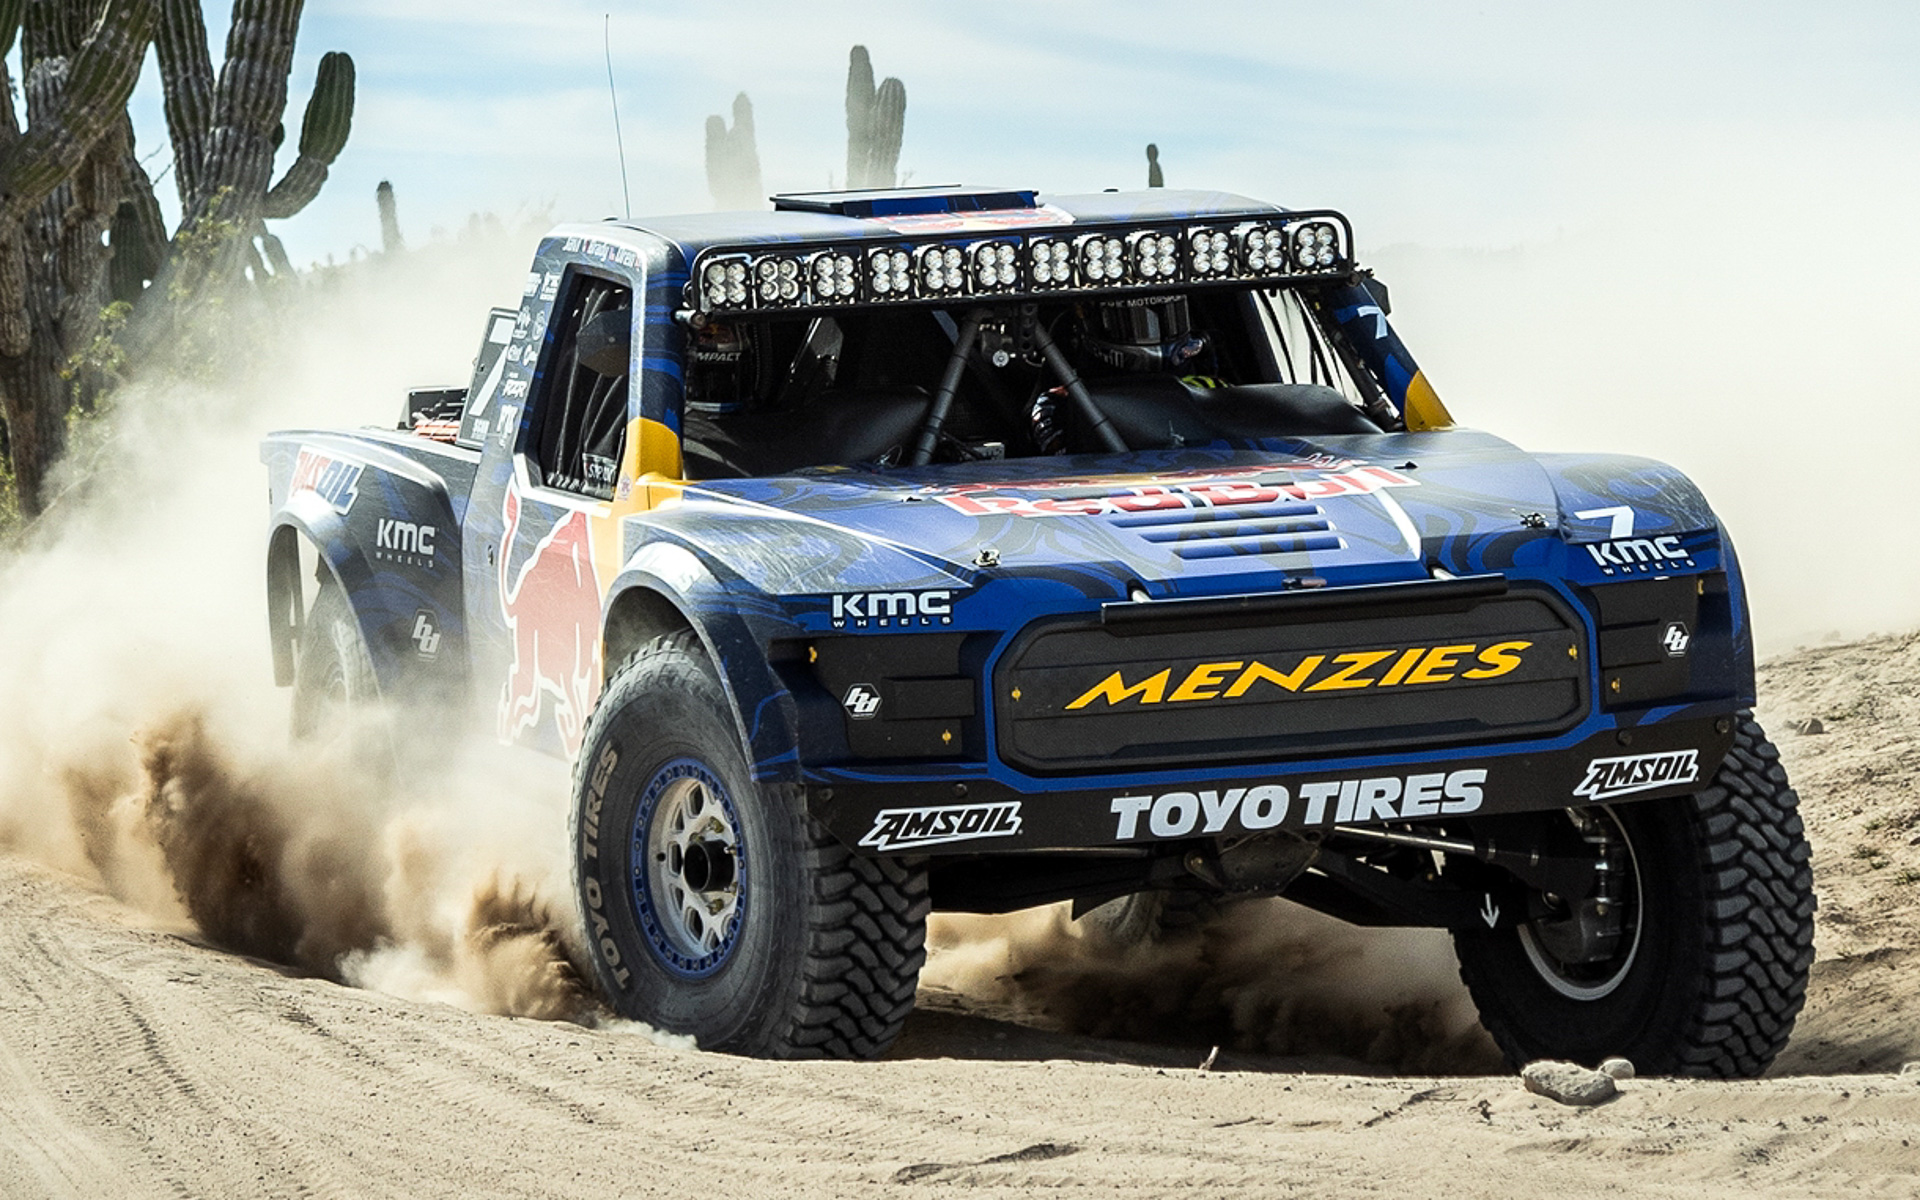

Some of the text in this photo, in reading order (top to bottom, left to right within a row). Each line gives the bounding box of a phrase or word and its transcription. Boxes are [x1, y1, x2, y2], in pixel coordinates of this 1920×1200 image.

[1357, 305, 1388, 339] 7
[377, 518, 435, 555] KMC
[1574, 506, 1634, 538] 7
[376, 552, 433, 567] WHEELS
[1586, 536, 1689, 566] KMC
[1603, 559, 1695, 575] WHEELS
[833, 591, 950, 618] KMC
[833, 617, 951, 627] WHEELS
[1064, 641, 1533, 710] MENZIES
[1573, 749, 1699, 801] AMSOIL
[1111, 769, 1488, 840] TOYO TIRES
[857, 800, 1022, 851] AMSOIL
[583, 741, 630, 989] TOYO TIRES
